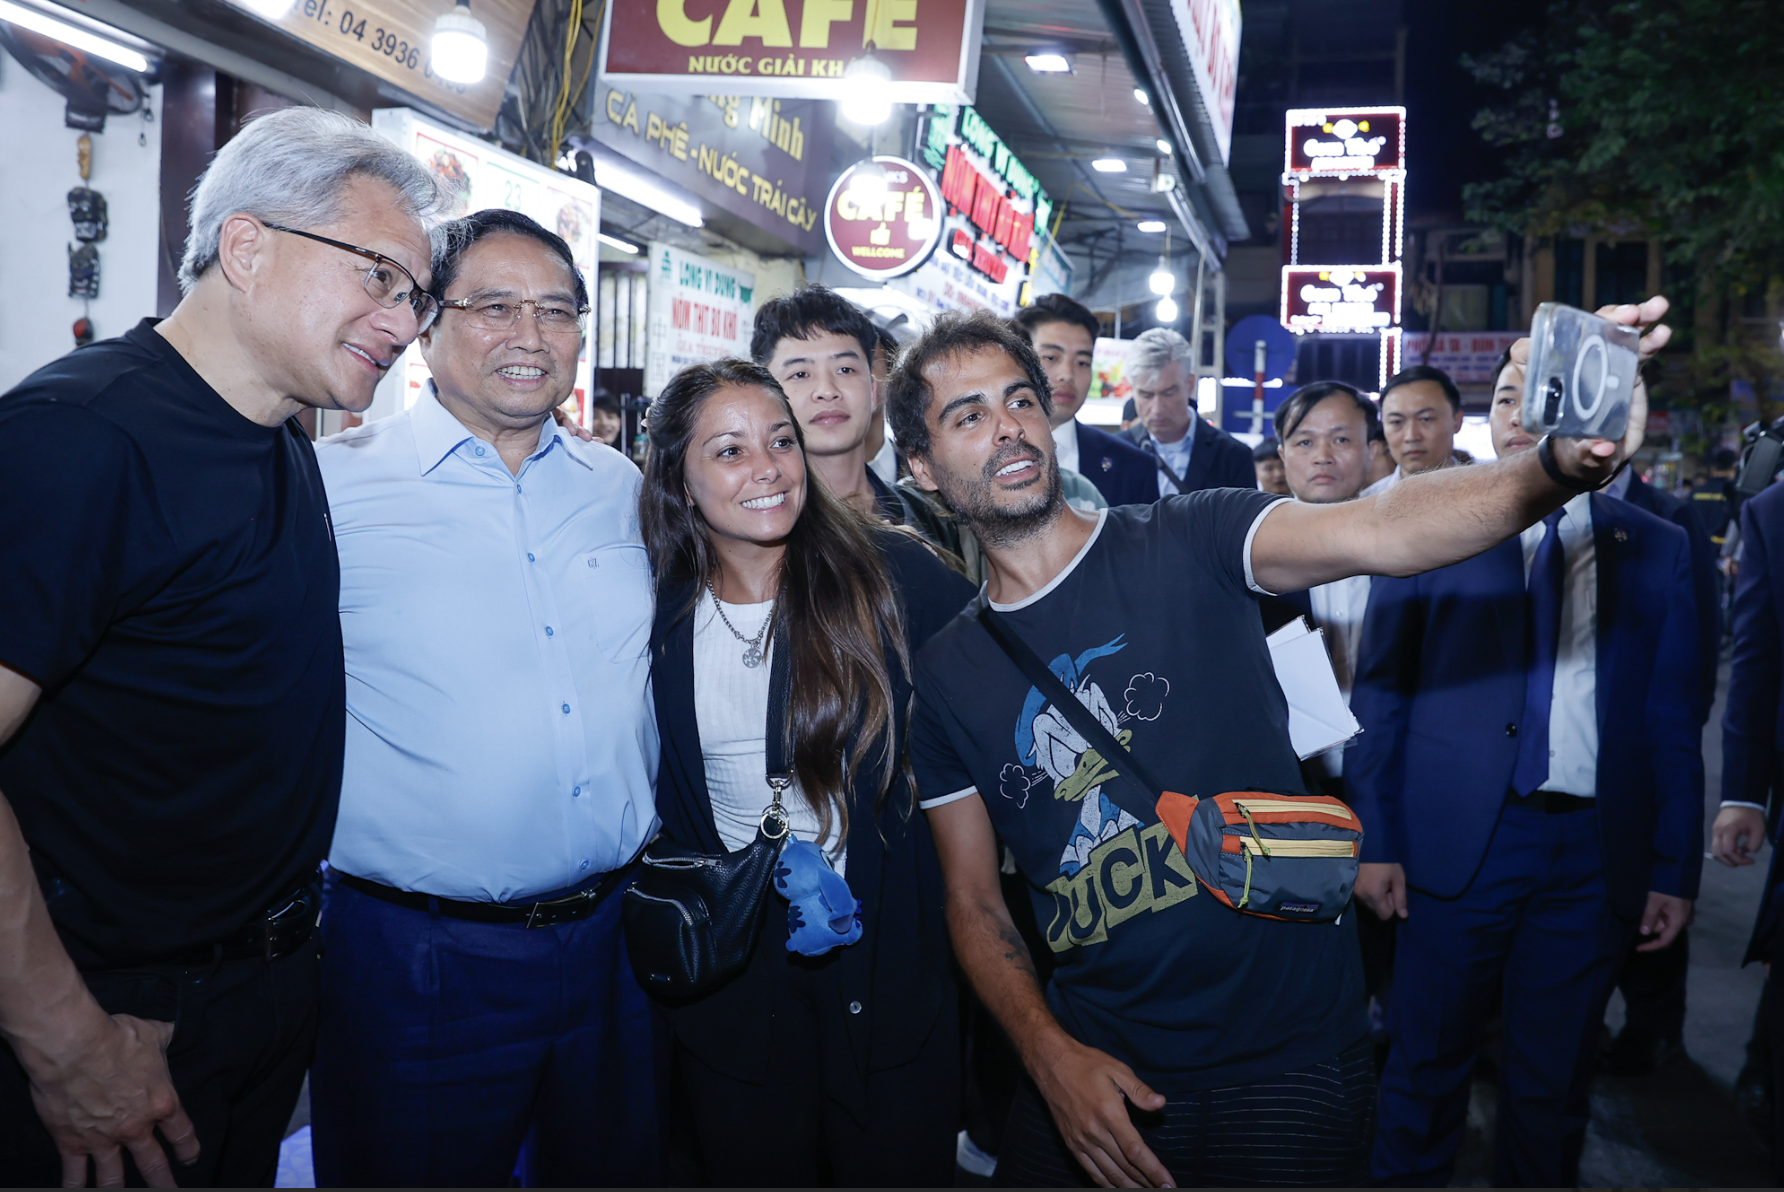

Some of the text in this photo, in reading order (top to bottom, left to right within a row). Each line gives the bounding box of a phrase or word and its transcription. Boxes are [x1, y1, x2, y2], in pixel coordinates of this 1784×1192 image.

[339, 11, 367, 42] 04
[371, 28, 420, 70] 3936
[688, 53, 752, 75] NƯỚC
[757, 53, 805, 77] GIẢI
[645, 111, 690, 162] PHÊ
[751, 173, 787, 217] TRÁI
[786, 196, 817, 232] CÂY
[504, 180, 522, 211] 23
[680, 261, 701, 290] LONG
